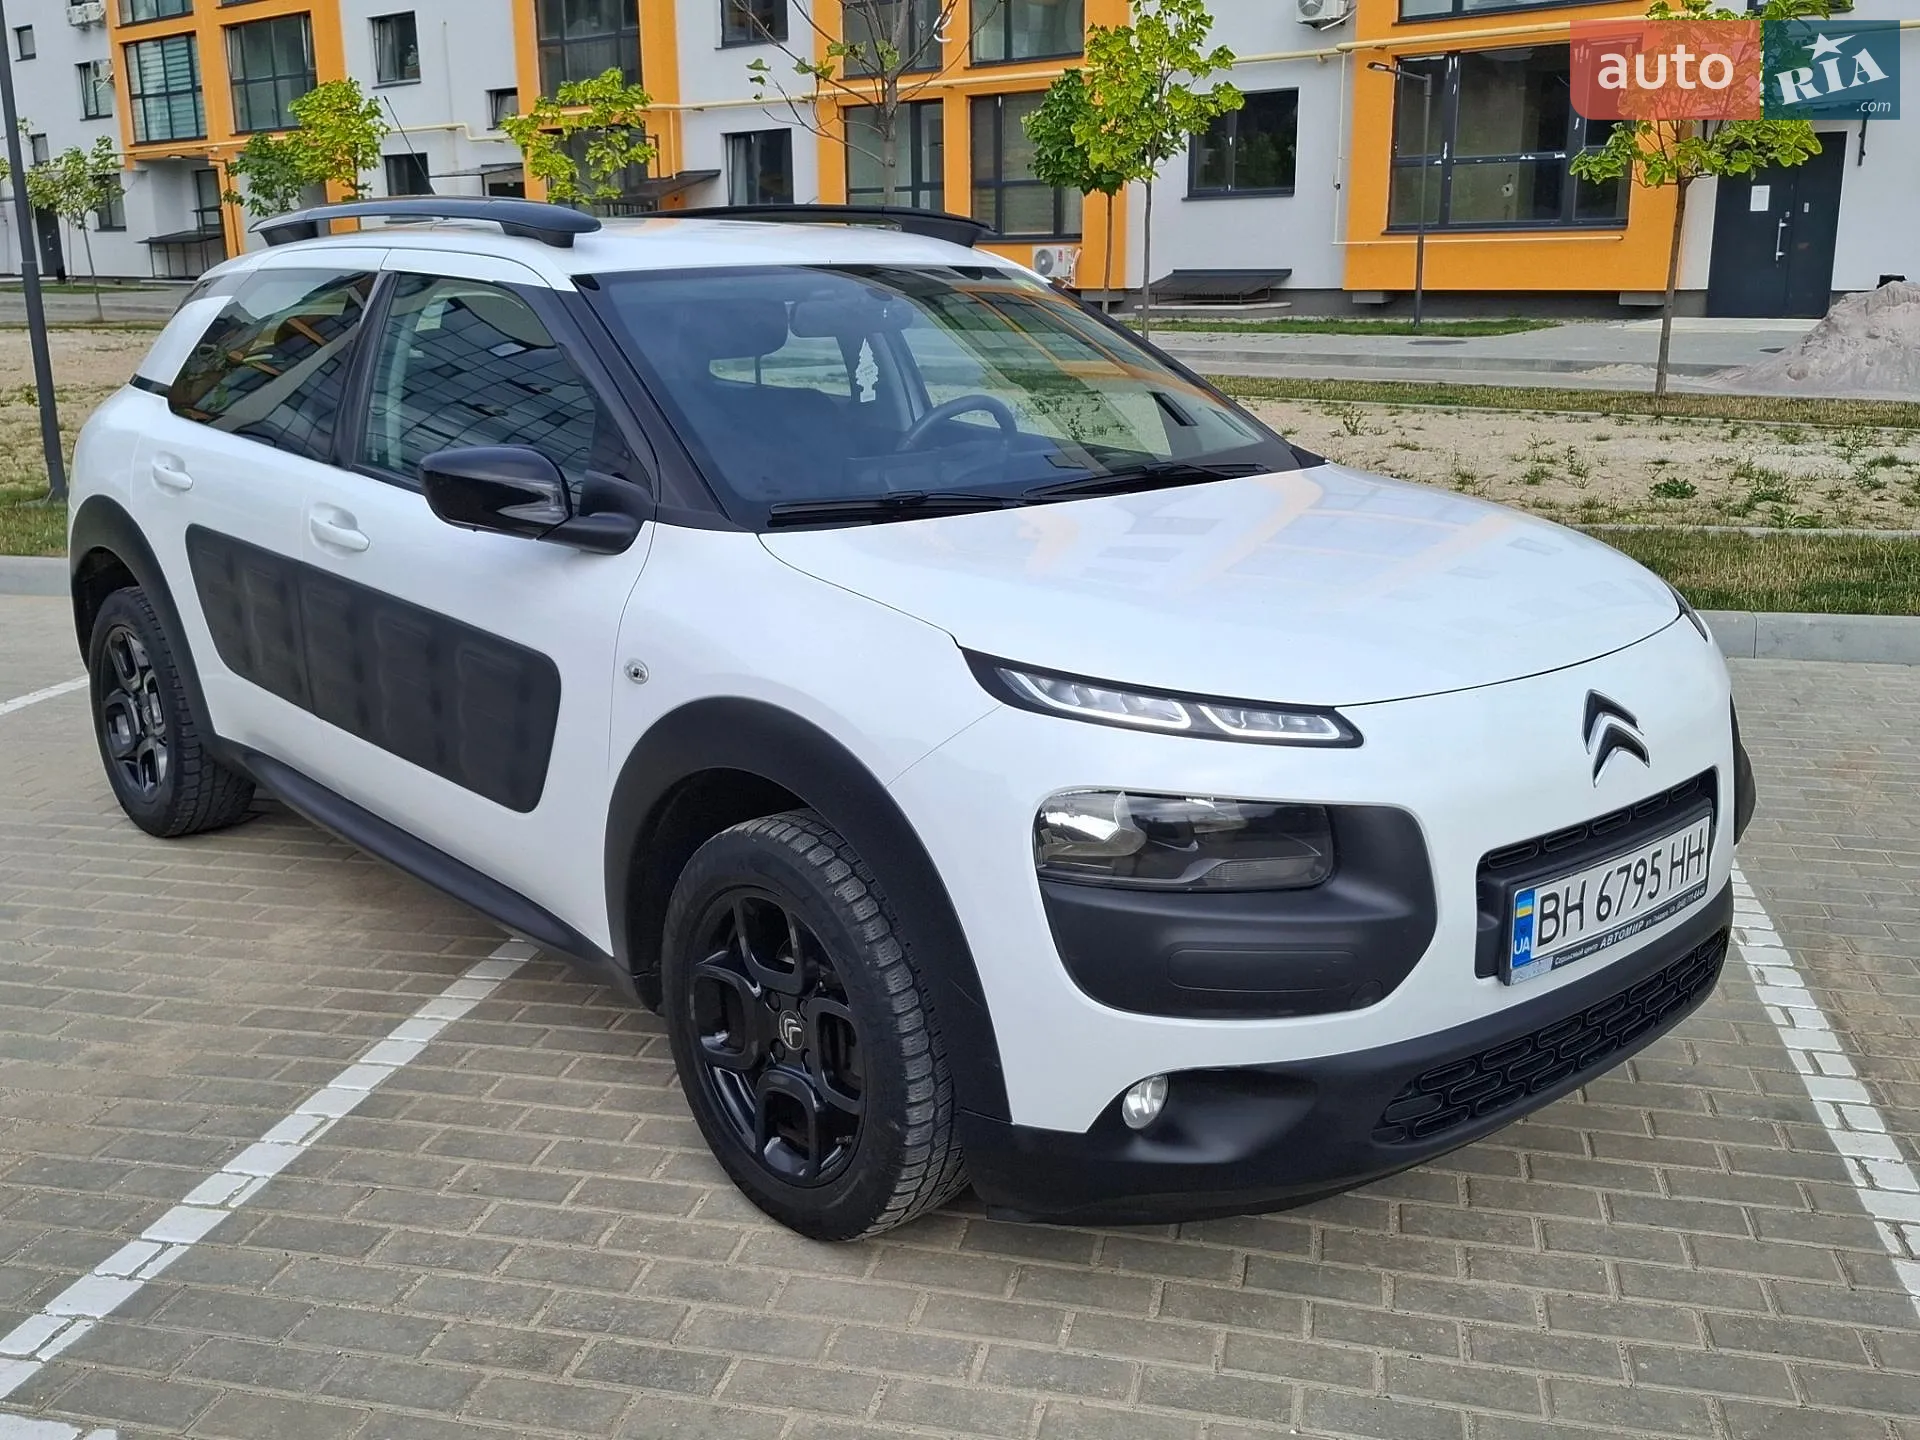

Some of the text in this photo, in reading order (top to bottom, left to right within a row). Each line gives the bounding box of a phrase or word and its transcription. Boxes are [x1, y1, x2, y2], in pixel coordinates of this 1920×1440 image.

[1537, 878, 1587, 947] BH
[1595, 849, 1662, 922] 6795
[1668, 827, 1705, 891] HH
[1514, 936, 1530, 955] UA
[1599, 920, 1644, 949] АВТОМИР
